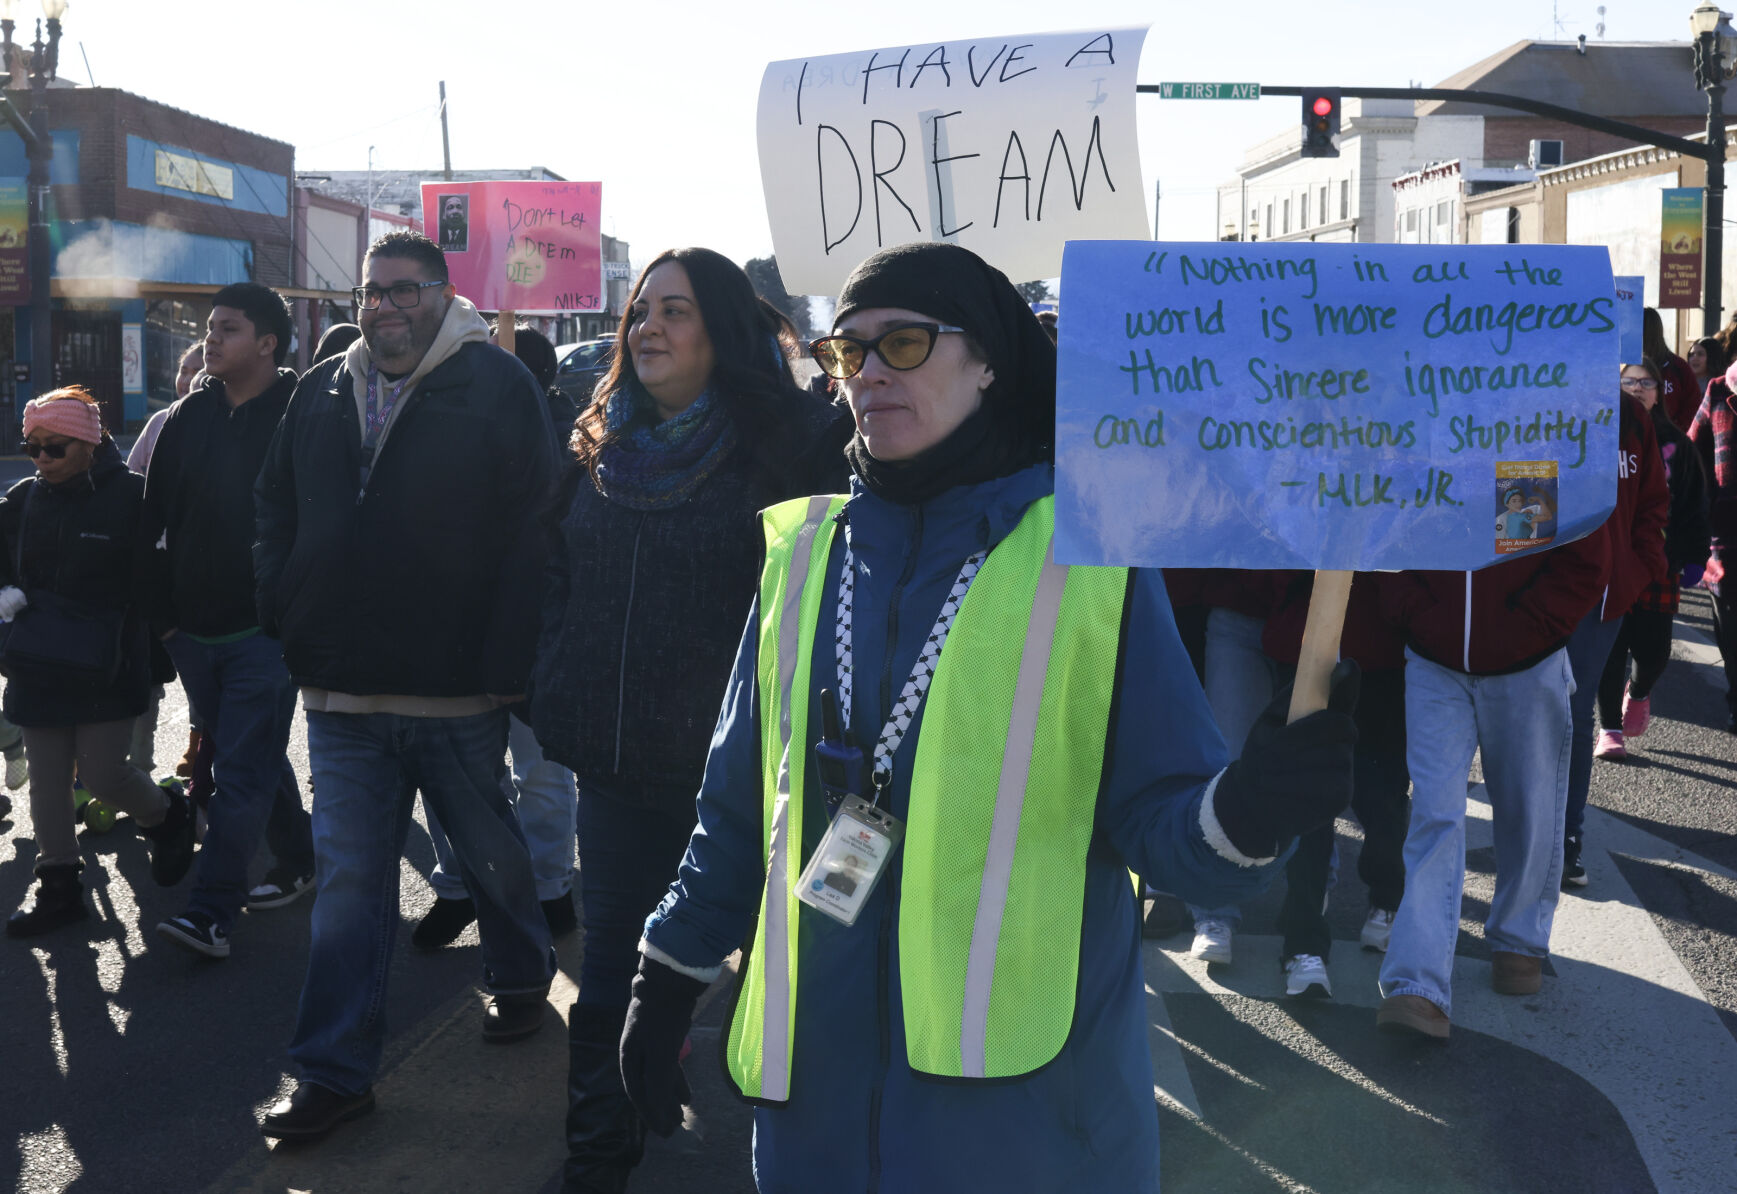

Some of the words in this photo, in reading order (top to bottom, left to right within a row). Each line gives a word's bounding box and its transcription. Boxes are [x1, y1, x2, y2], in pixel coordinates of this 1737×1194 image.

[795, 61, 808, 125] I
[862, 44, 1038, 104] HAVE
[1064, 32, 1115, 67] A
[1162, 84, 1173, 98] W
[1182, 84, 1222, 98] FIRST
[1231, 84, 1257, 99] AVE
[817, 110, 1116, 256] DREAM
[561, 208, 587, 231] Let
[505, 233, 516, 254] A
[606, 269, 628, 277] ENSE
[1352, 254, 1390, 283] in
[1412, 260, 1470, 283] all
[1495, 258, 1563, 286] the
[1664, 271, 1677, 279] the
[1678, 271, 1697, 279] West
[1124, 300, 1226, 340] world
[1260, 298, 1293, 342] is
[1314, 300, 1398, 338] more
[1422, 294, 1616, 355] dangerous
[1119, 349, 1223, 396] than
[1404, 350, 1570, 418] ignorance
[1092, 409, 1166, 450] and
[1199, 412, 1417, 451] conscientious
